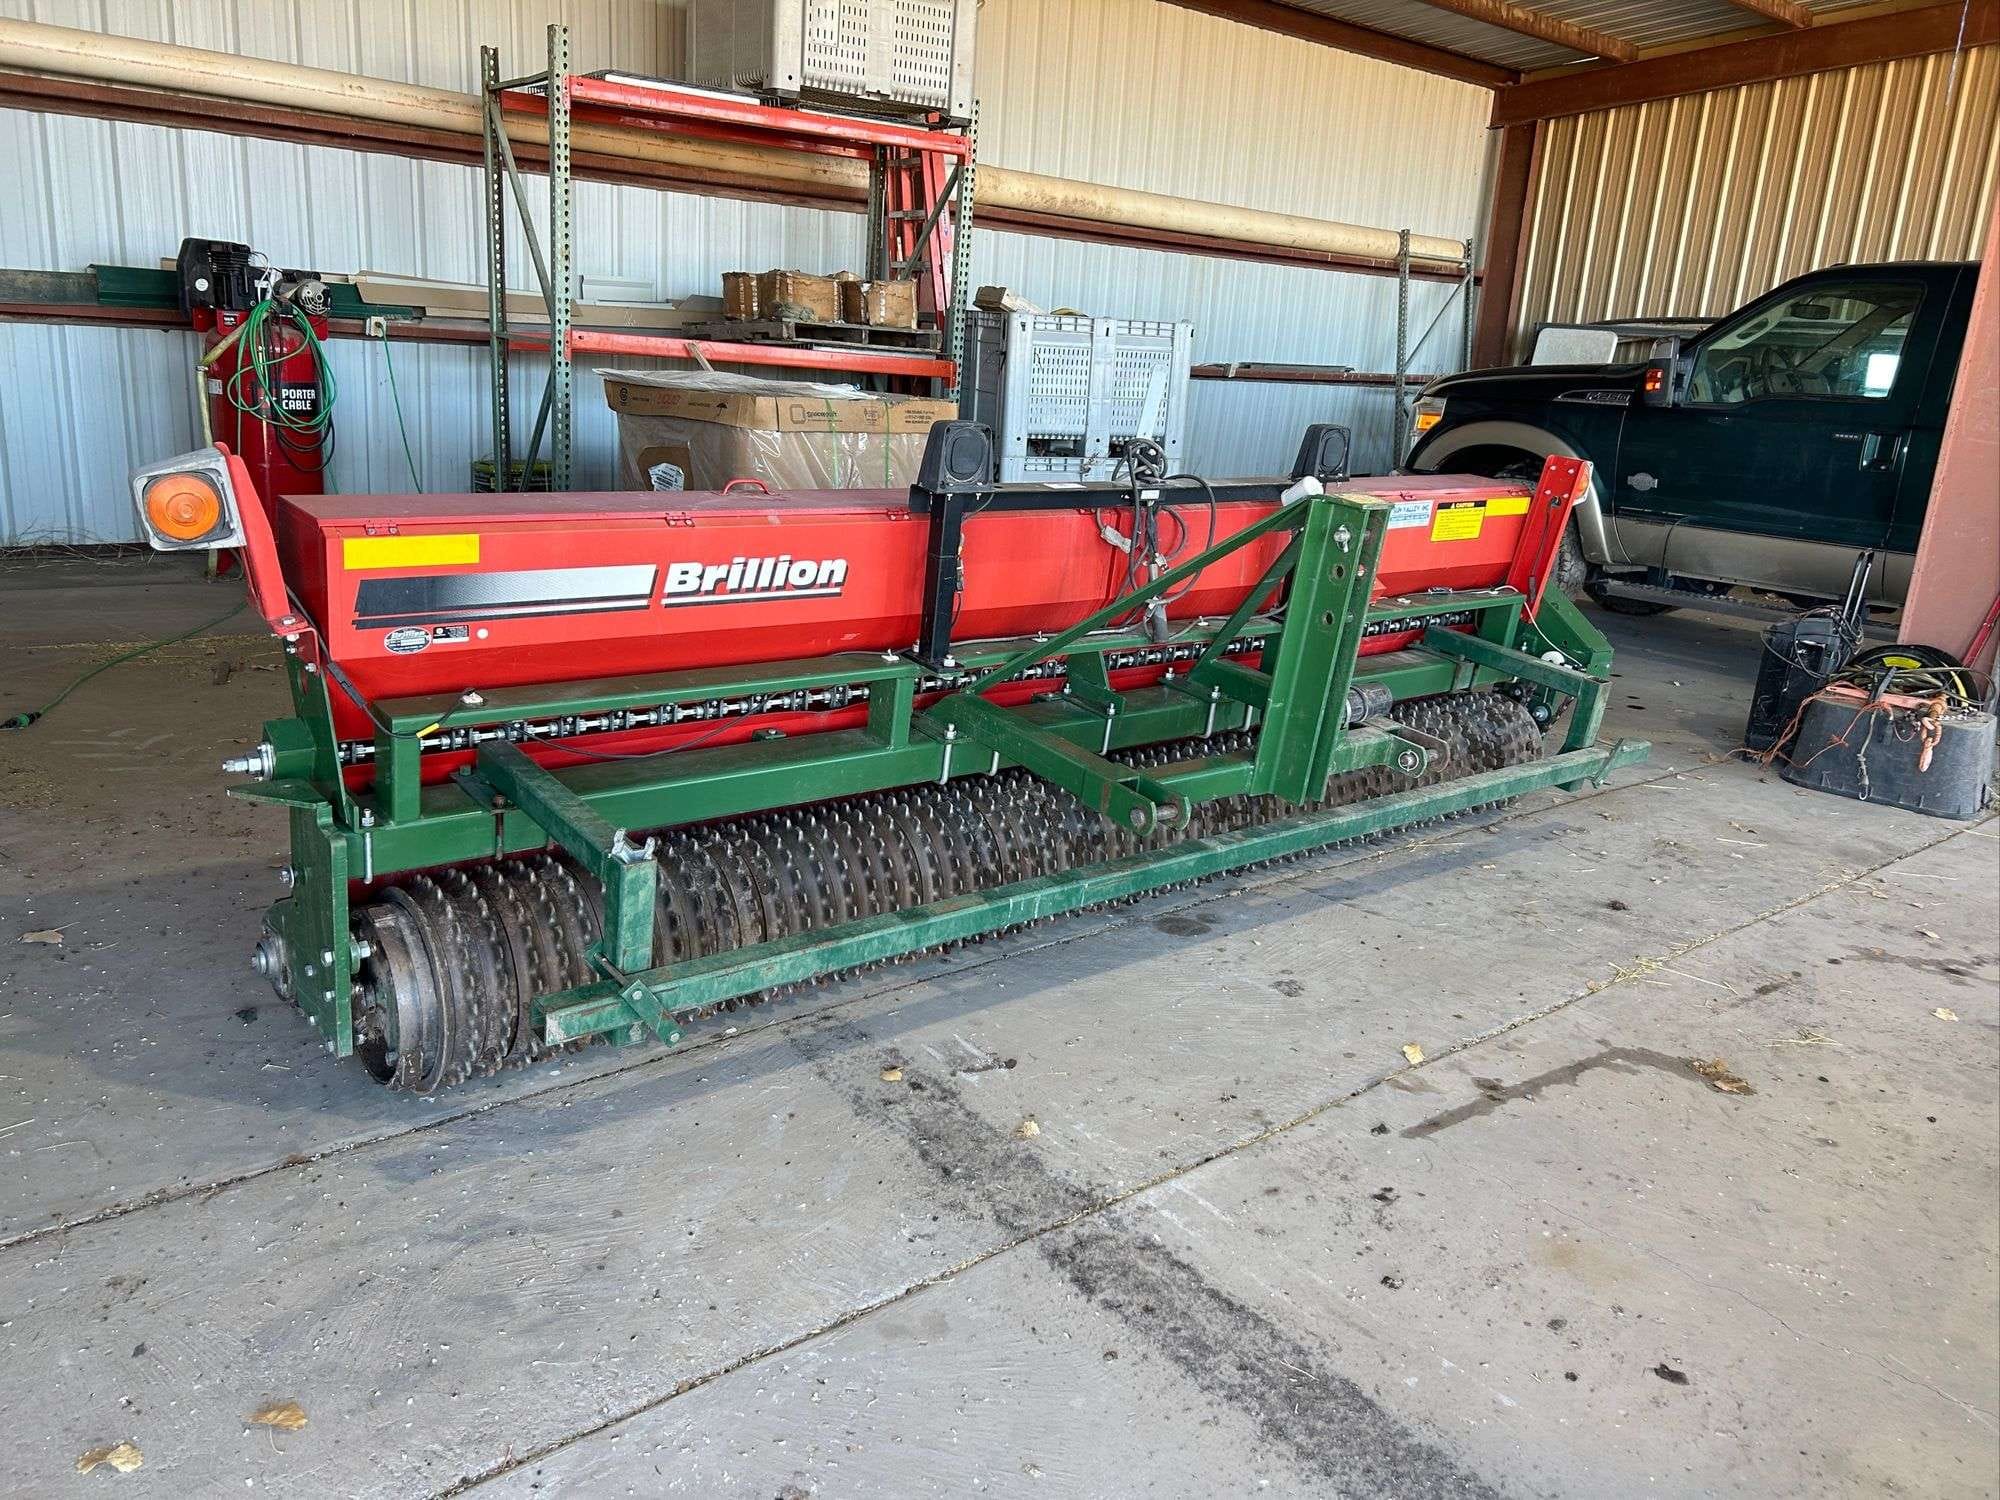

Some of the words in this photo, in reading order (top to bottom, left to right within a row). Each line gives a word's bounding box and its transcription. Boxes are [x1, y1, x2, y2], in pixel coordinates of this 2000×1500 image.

[281, 388, 316, 400] PORTER
[282, 400, 313, 411] CABLE
[663, 554, 848, 595] Brillion
